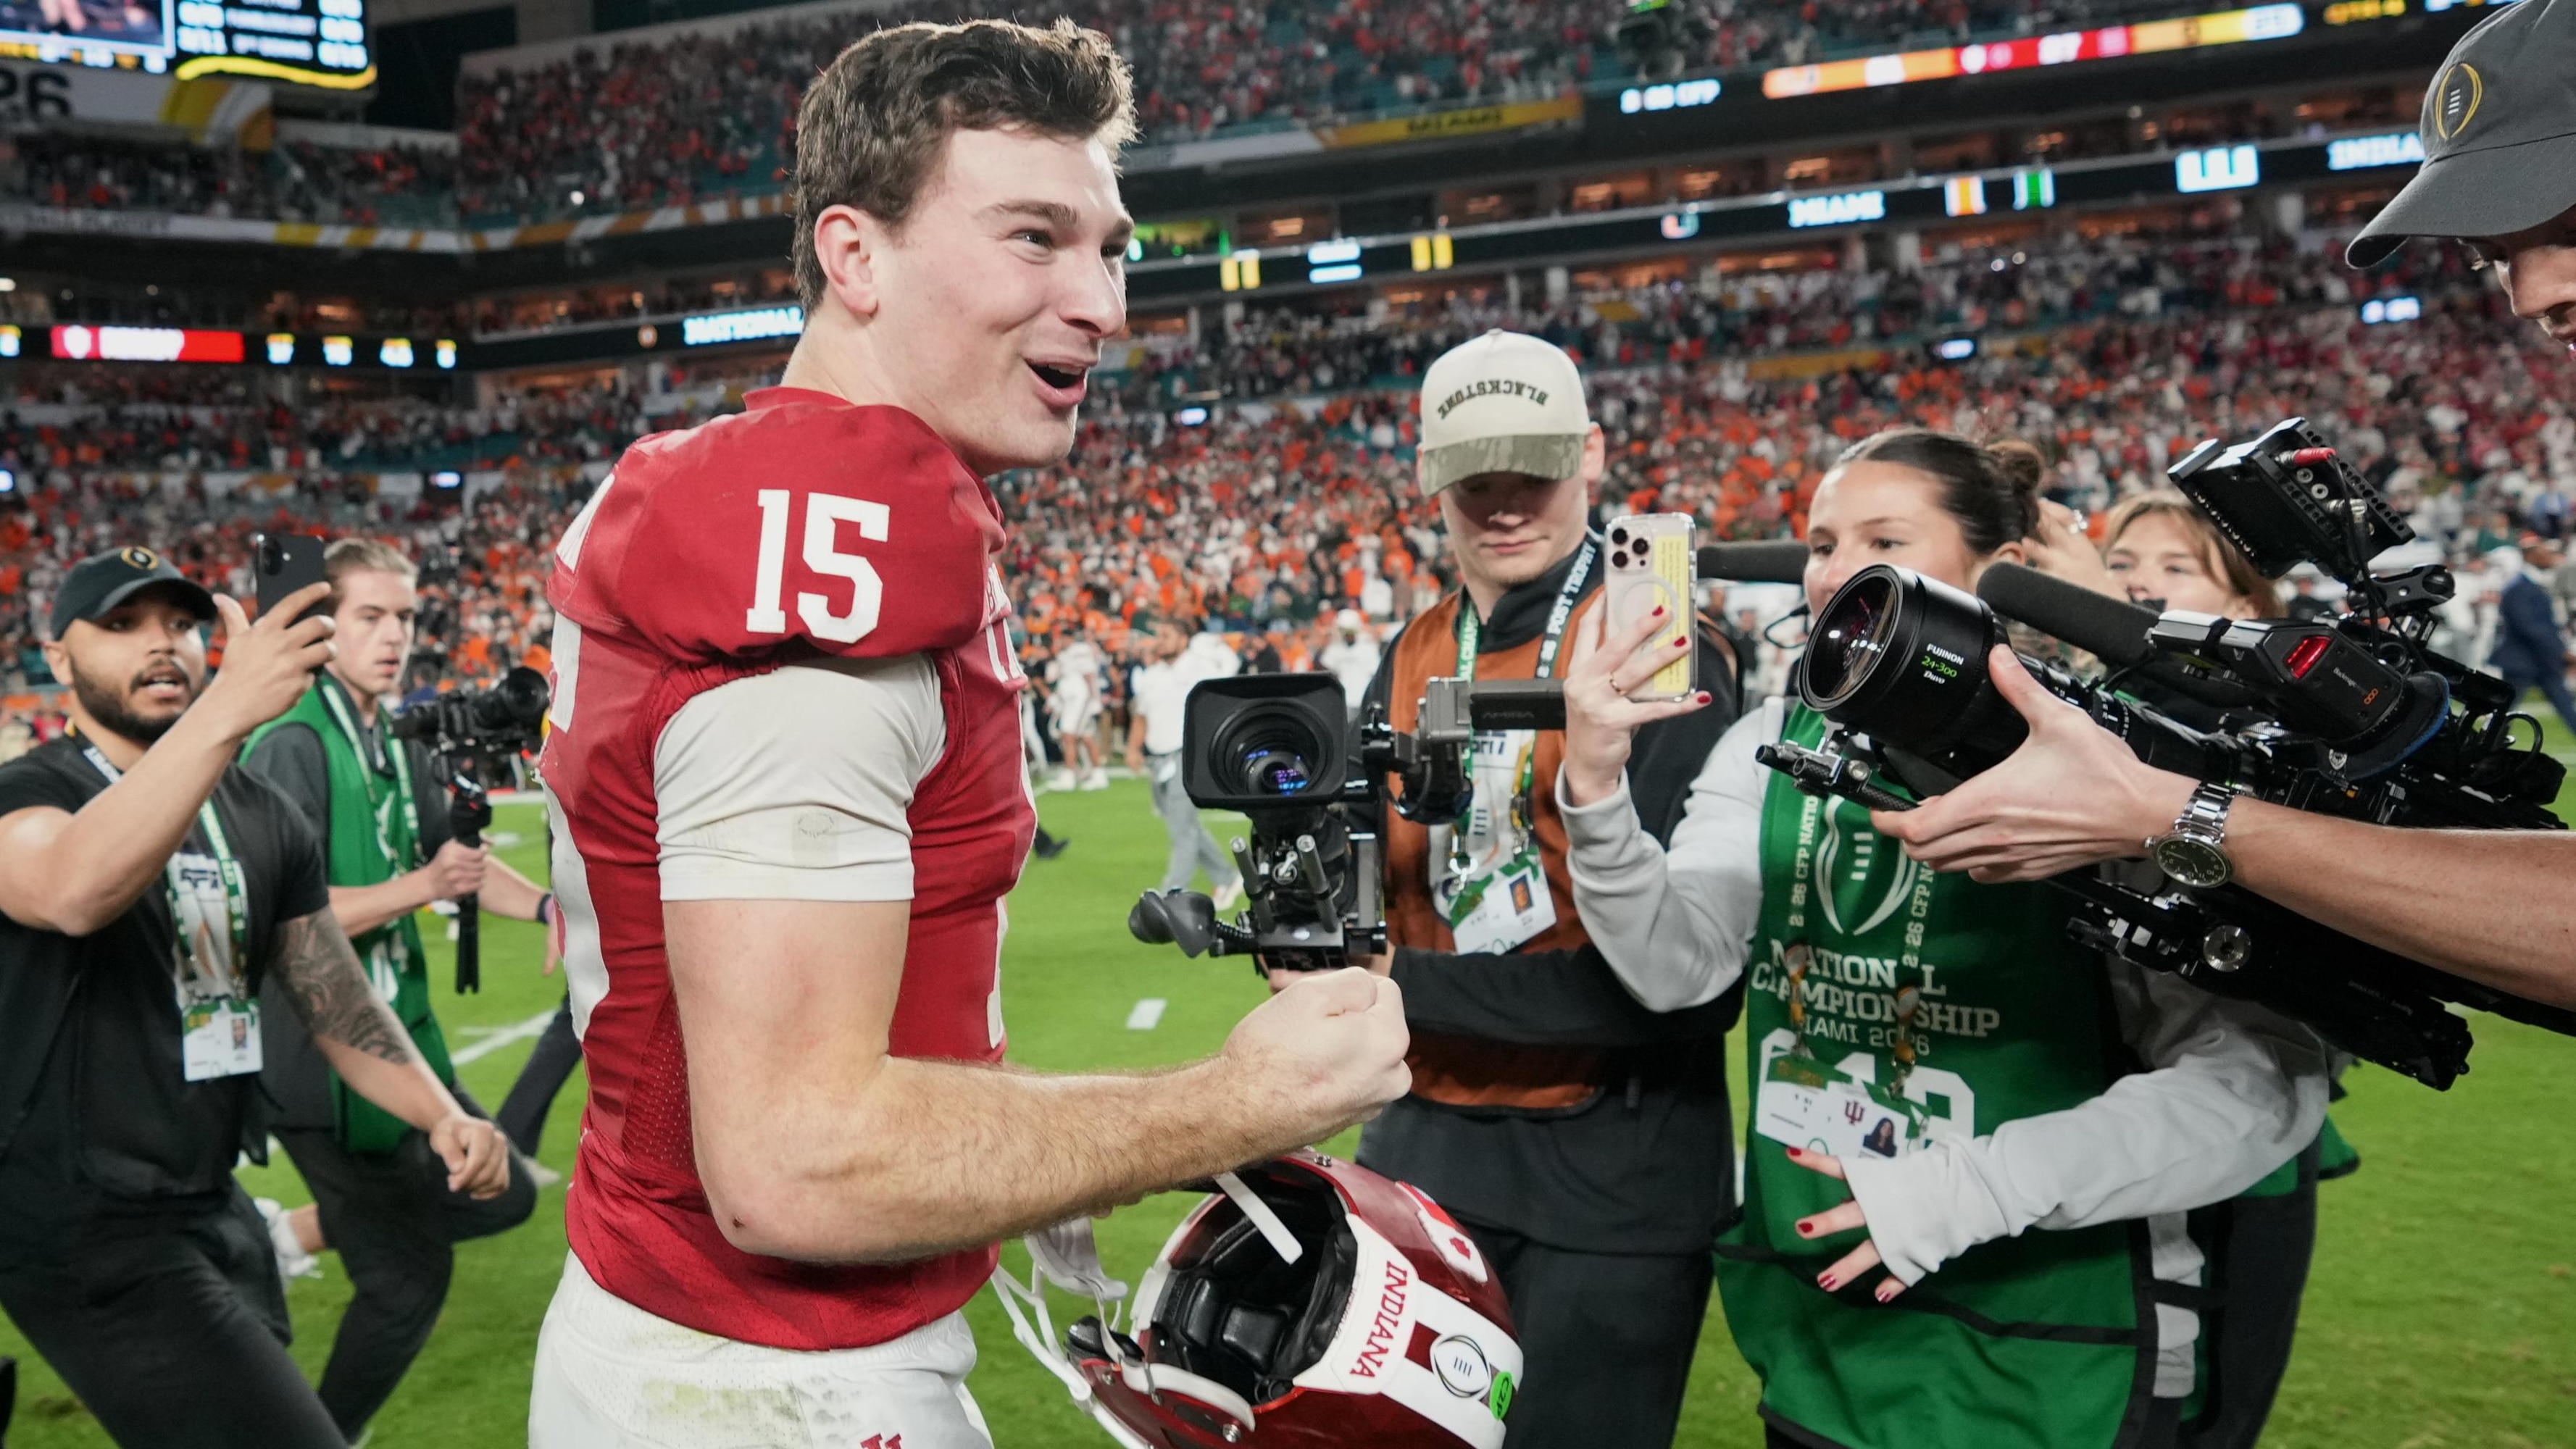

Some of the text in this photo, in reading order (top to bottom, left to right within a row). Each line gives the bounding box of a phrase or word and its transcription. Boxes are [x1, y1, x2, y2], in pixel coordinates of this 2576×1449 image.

[1437, 380, 1549, 420] BLACKSTONE
[746, 488, 891, 644] 15
[1546, 593, 1574, 636] POST
[1921, 655, 1958, 678] 24-300
[1926, 643, 1964, 666] FUJINON
[1796, 846, 1811, 880] CFP
[1788, 882, 1807, 928] 226
[1911, 882, 1931, 919] CFP
[1902, 921, 1925, 969] 226
[1770, 938, 1947, 998] NATIONL
[1804, 1014, 1930, 1057] IAMI 206
[1349, 1260, 1408, 1378] INDIANA
